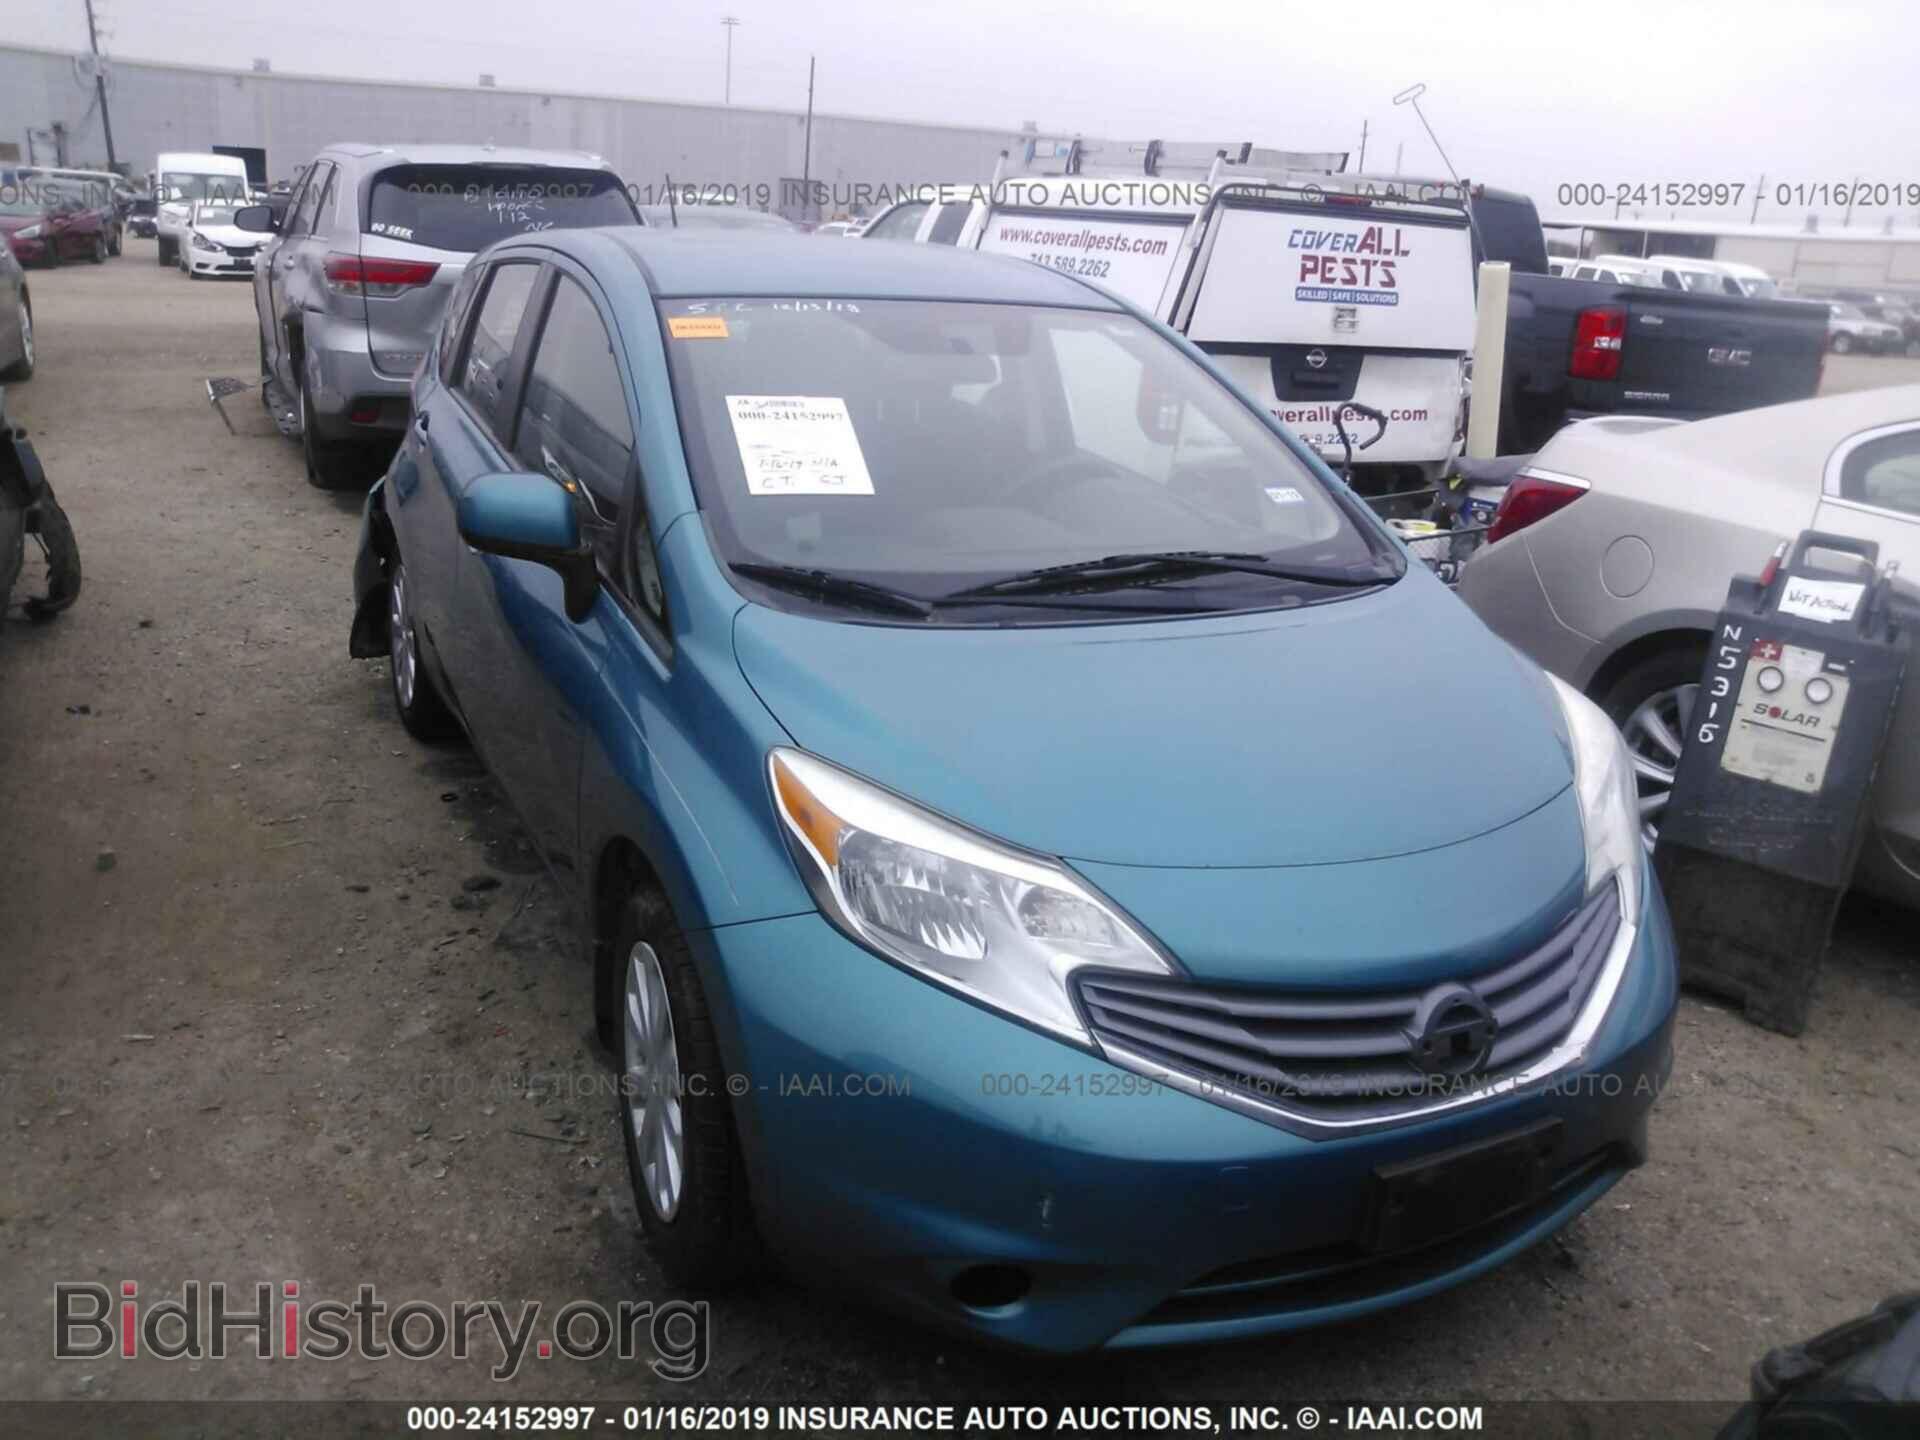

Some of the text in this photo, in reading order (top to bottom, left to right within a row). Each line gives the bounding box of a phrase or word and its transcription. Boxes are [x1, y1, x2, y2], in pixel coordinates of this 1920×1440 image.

[1000, 225, 1169, 256] www.coverallpests.com
[1299, 254, 1397, 289] PESTS
[1296, 288, 1397, 304] SKILLED SAFE SOLUTIONS
[1753, 702, 1821, 728] SOLAR
